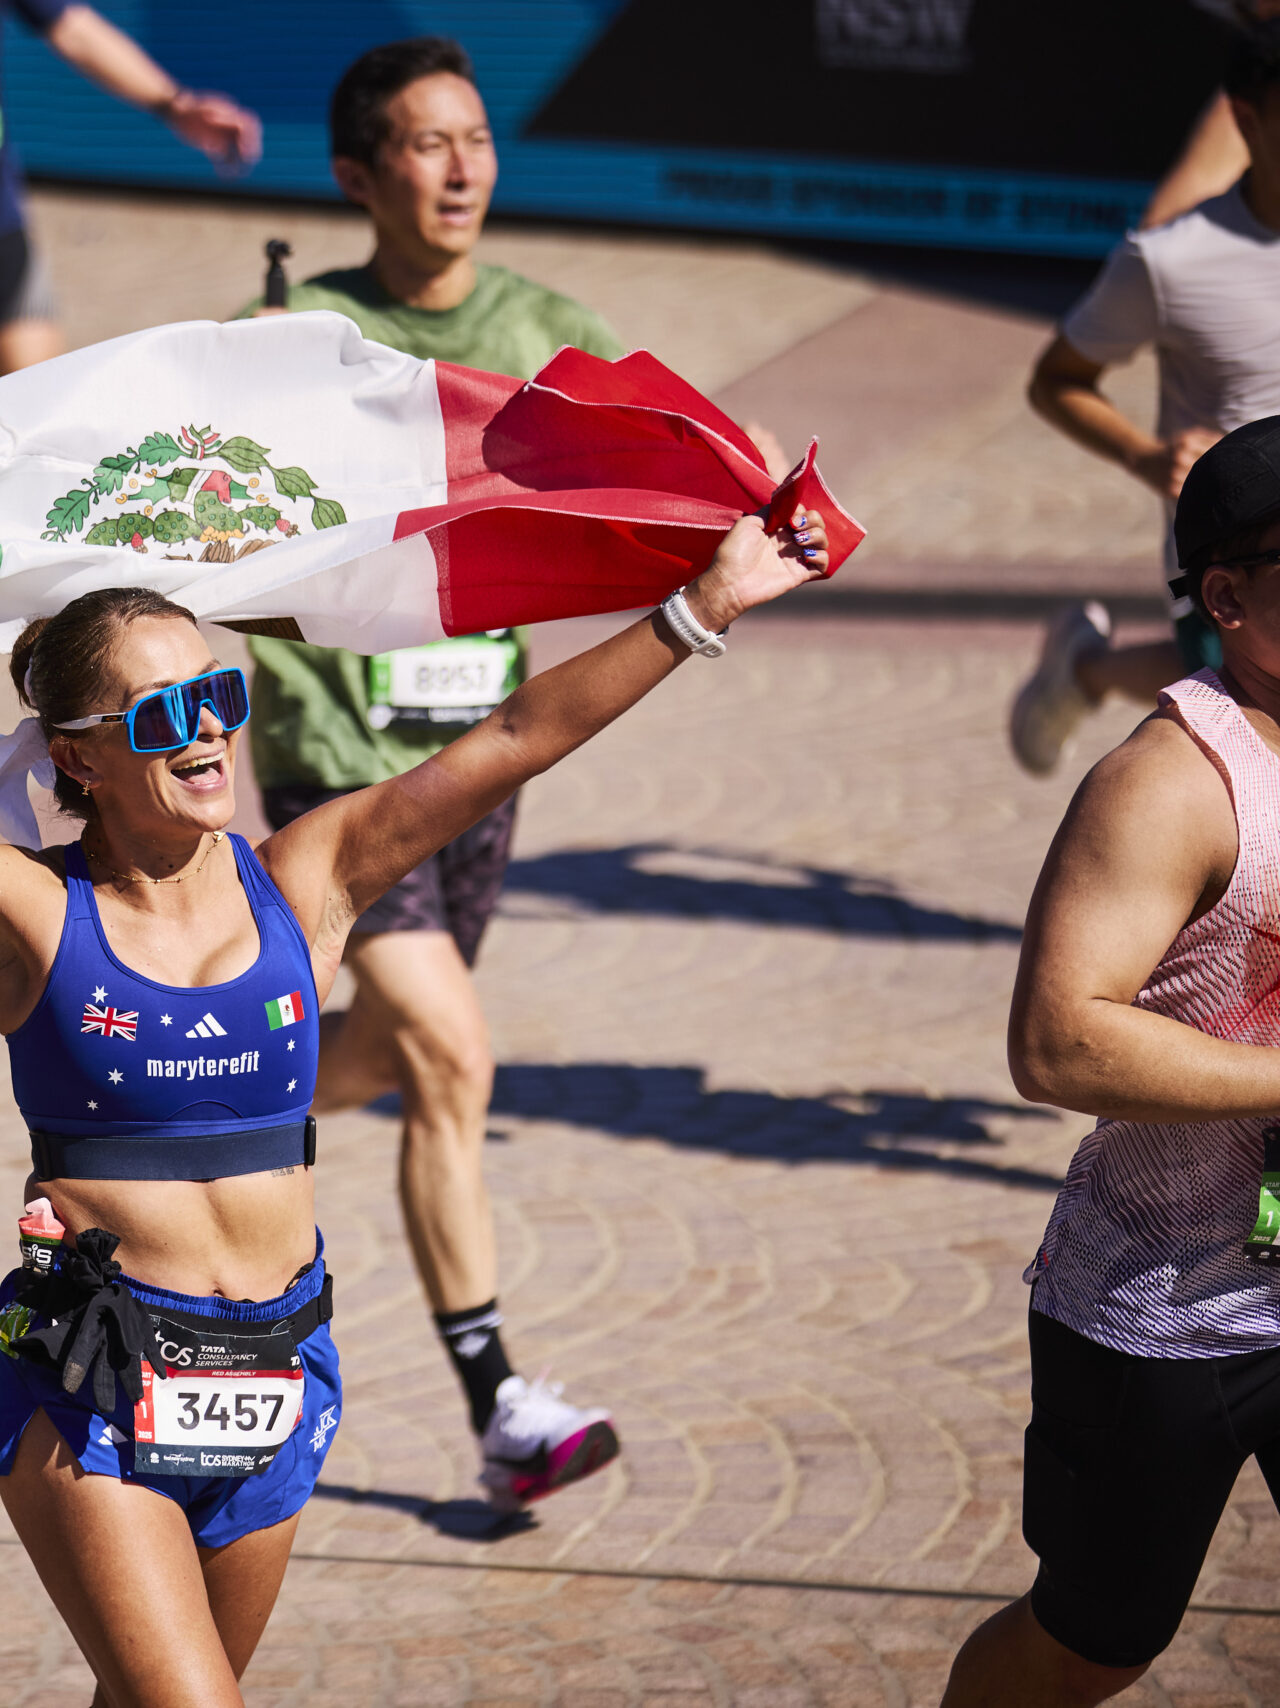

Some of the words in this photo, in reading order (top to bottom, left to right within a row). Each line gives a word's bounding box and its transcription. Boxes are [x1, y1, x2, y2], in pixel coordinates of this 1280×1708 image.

[147, 1051, 259, 1080] maryterefit
[1267, 1210, 1273, 1228] 1
[198, 1353, 258, 1361] CONSULTANCY
[200, 1345, 226, 1353] TATA
[140, 1401, 147, 1418] 1
[177, 1392, 284, 1431] 3457
[138, 1430, 152, 1439] 2025
